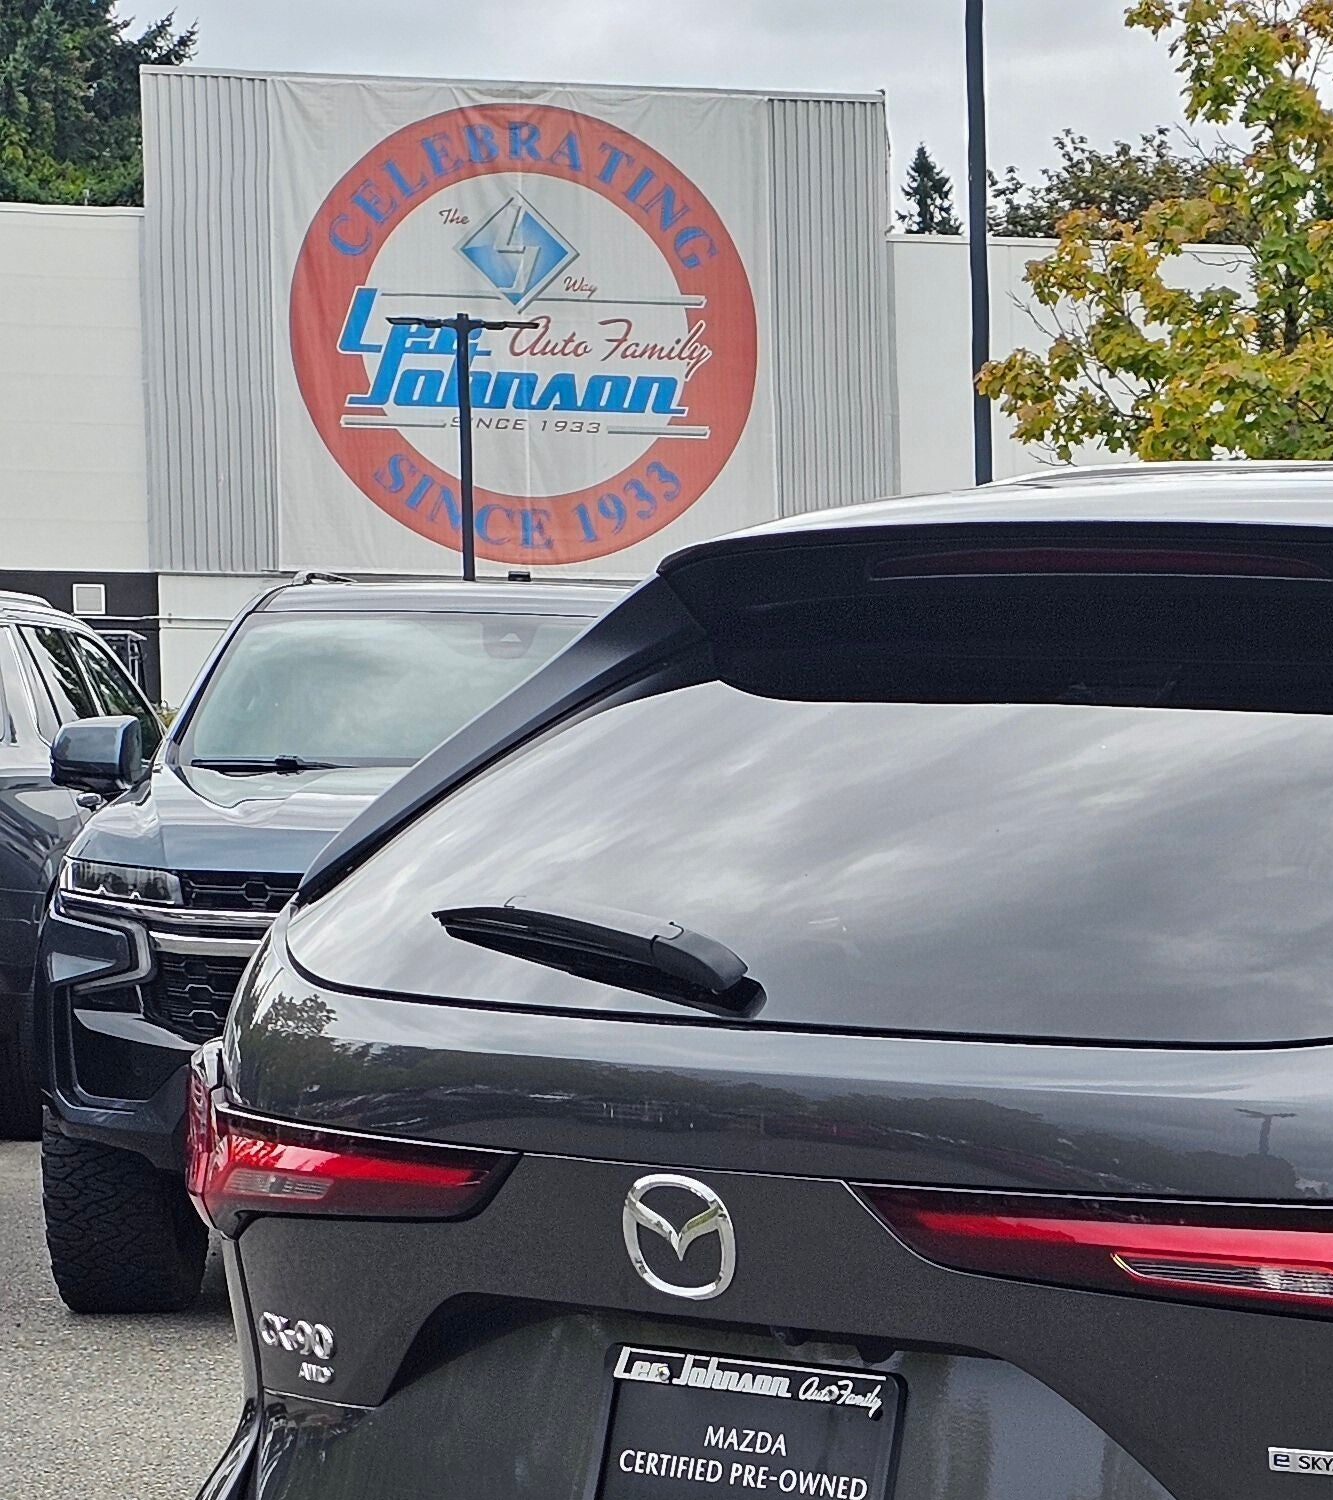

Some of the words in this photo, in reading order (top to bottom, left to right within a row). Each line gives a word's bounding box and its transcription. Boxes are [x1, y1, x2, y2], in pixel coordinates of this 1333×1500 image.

[328, 120, 719, 269] CELEBRATING
[438, 208, 470, 226] The
[563, 276, 598, 297] Way
[509, 315, 592, 358] Auto
[599, 318, 712, 378] Family
[346, 322, 688, 415] Johnson
[450, 416, 527, 431] SNCE
[540, 419, 601, 434] 1933
[373, 454, 554, 549] SINCE
[573, 460, 683, 543] 1933
[299, 1362, 334, 1384] AWD
[672, 1354, 792, 1398] Johnson
[836, 1379, 883, 1418] Family
[703, 1425, 788, 1457] MAZDA
[619, 1449, 724, 1484] CERTIFIED
